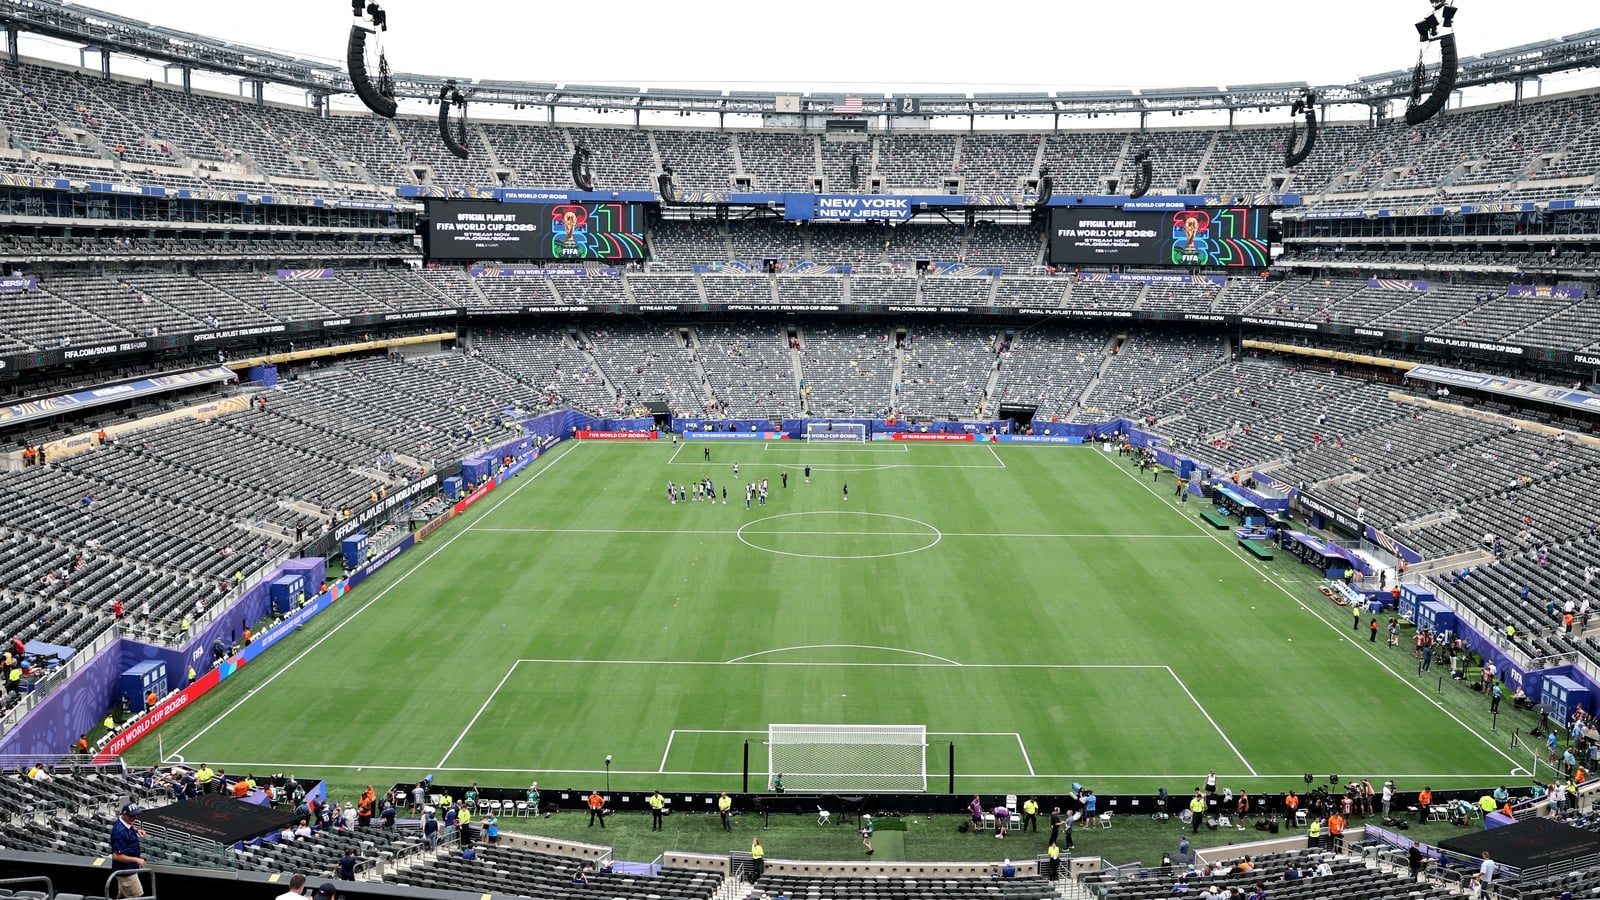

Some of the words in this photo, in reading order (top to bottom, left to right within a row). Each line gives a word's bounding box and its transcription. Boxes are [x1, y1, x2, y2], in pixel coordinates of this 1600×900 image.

[820, 199, 858, 207] NEW
[861, 199, 907, 208] YORK
[194, 333, 216, 341] OFFICIAL
[1445, 339, 1468, 347] PLAYLIST
[64, 345, 117, 359] FIFA.COM/SOUND
[334, 517, 360, 541] OFFICIAL
[359, 502, 384, 524] PLAYLIST
[385, 496, 396, 509] FIFA
[395, 487, 411, 502] WORLD
[411, 482, 420, 494] CUP
[1301, 496, 1334, 519] FIFA.COM/SOUND
[1336, 514, 1345, 525] FIFA
[193, 646, 204, 661] FIFA
[1511, 668, 1523, 686] FIFA
[110, 738, 125, 755] FIFA
[125, 721, 150, 743] WORLD
[150, 711, 164, 725] CUP
